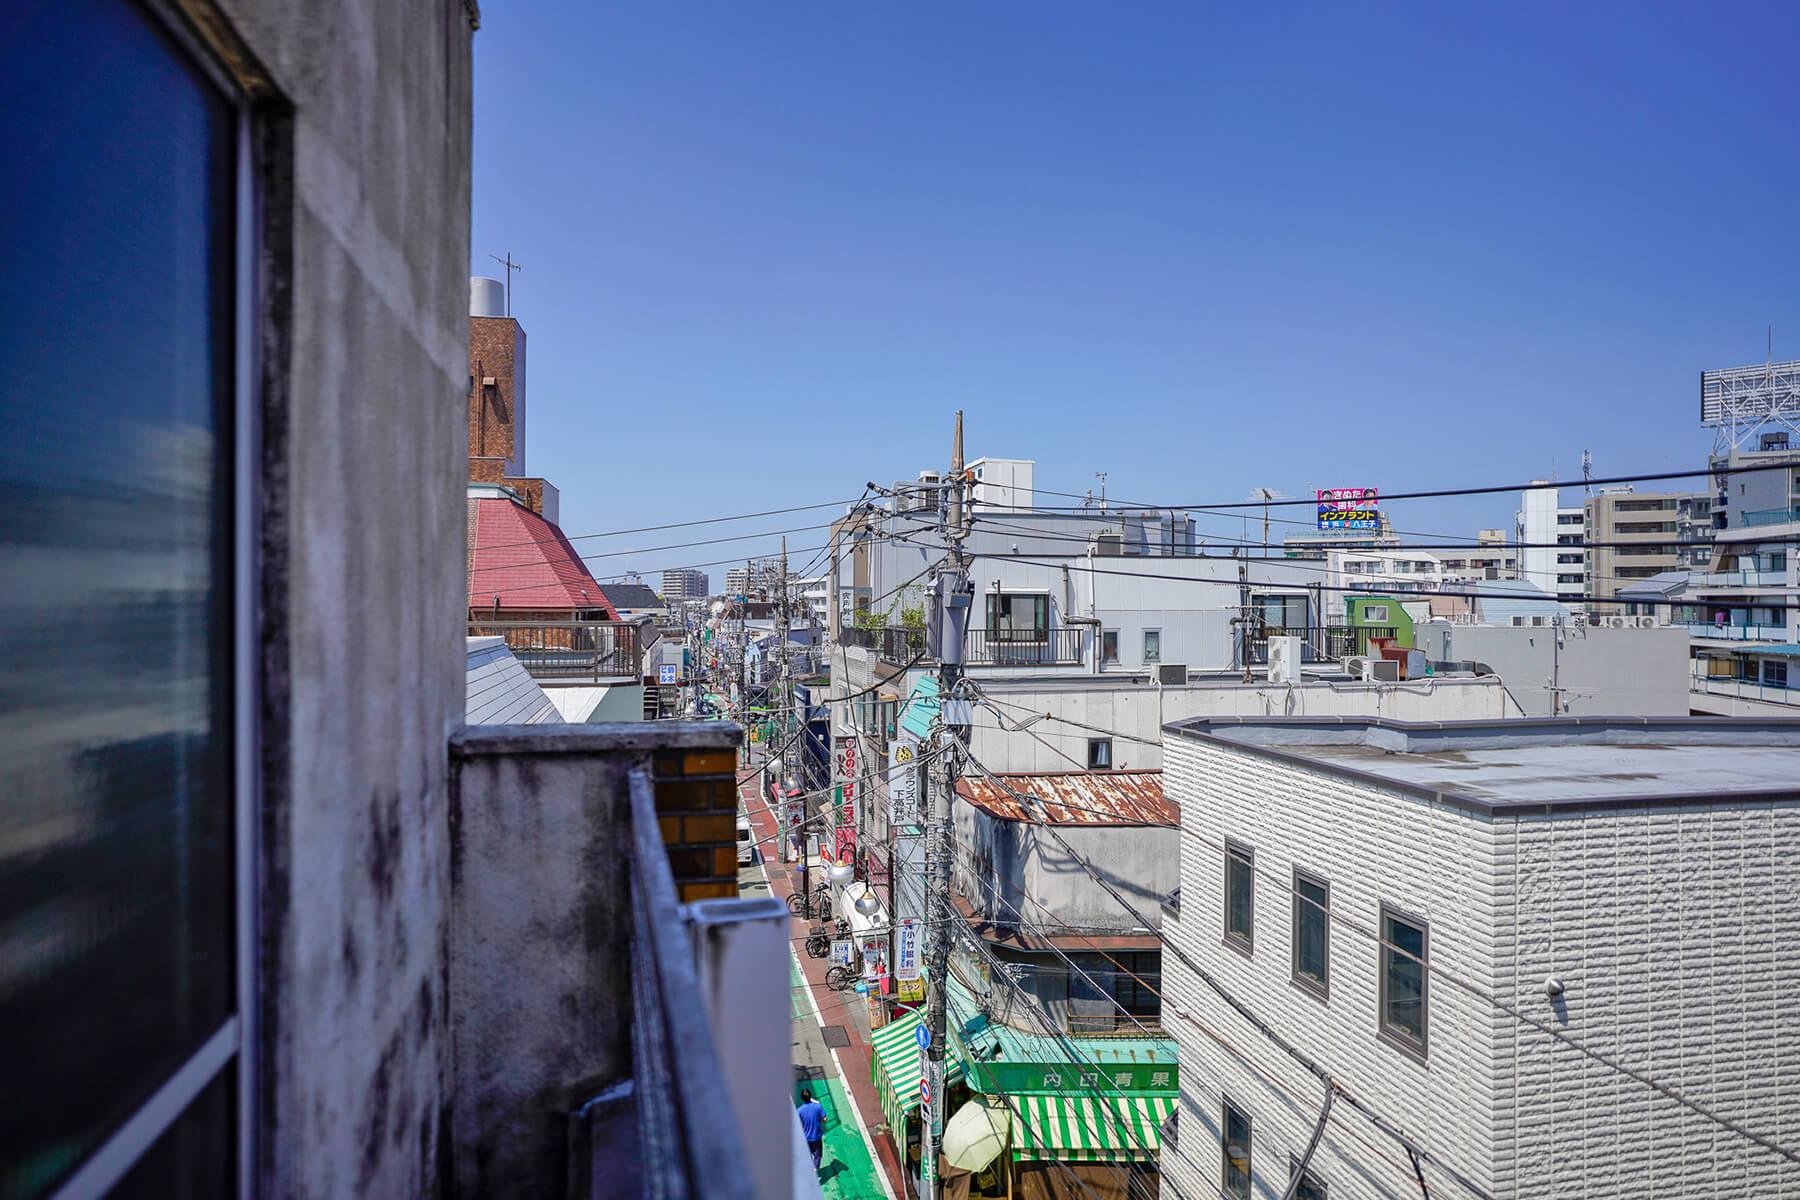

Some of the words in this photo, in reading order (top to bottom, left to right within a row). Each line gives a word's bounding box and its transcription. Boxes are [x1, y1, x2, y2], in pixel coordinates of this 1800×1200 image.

[1320, 511, 1374, 520] インプラント
